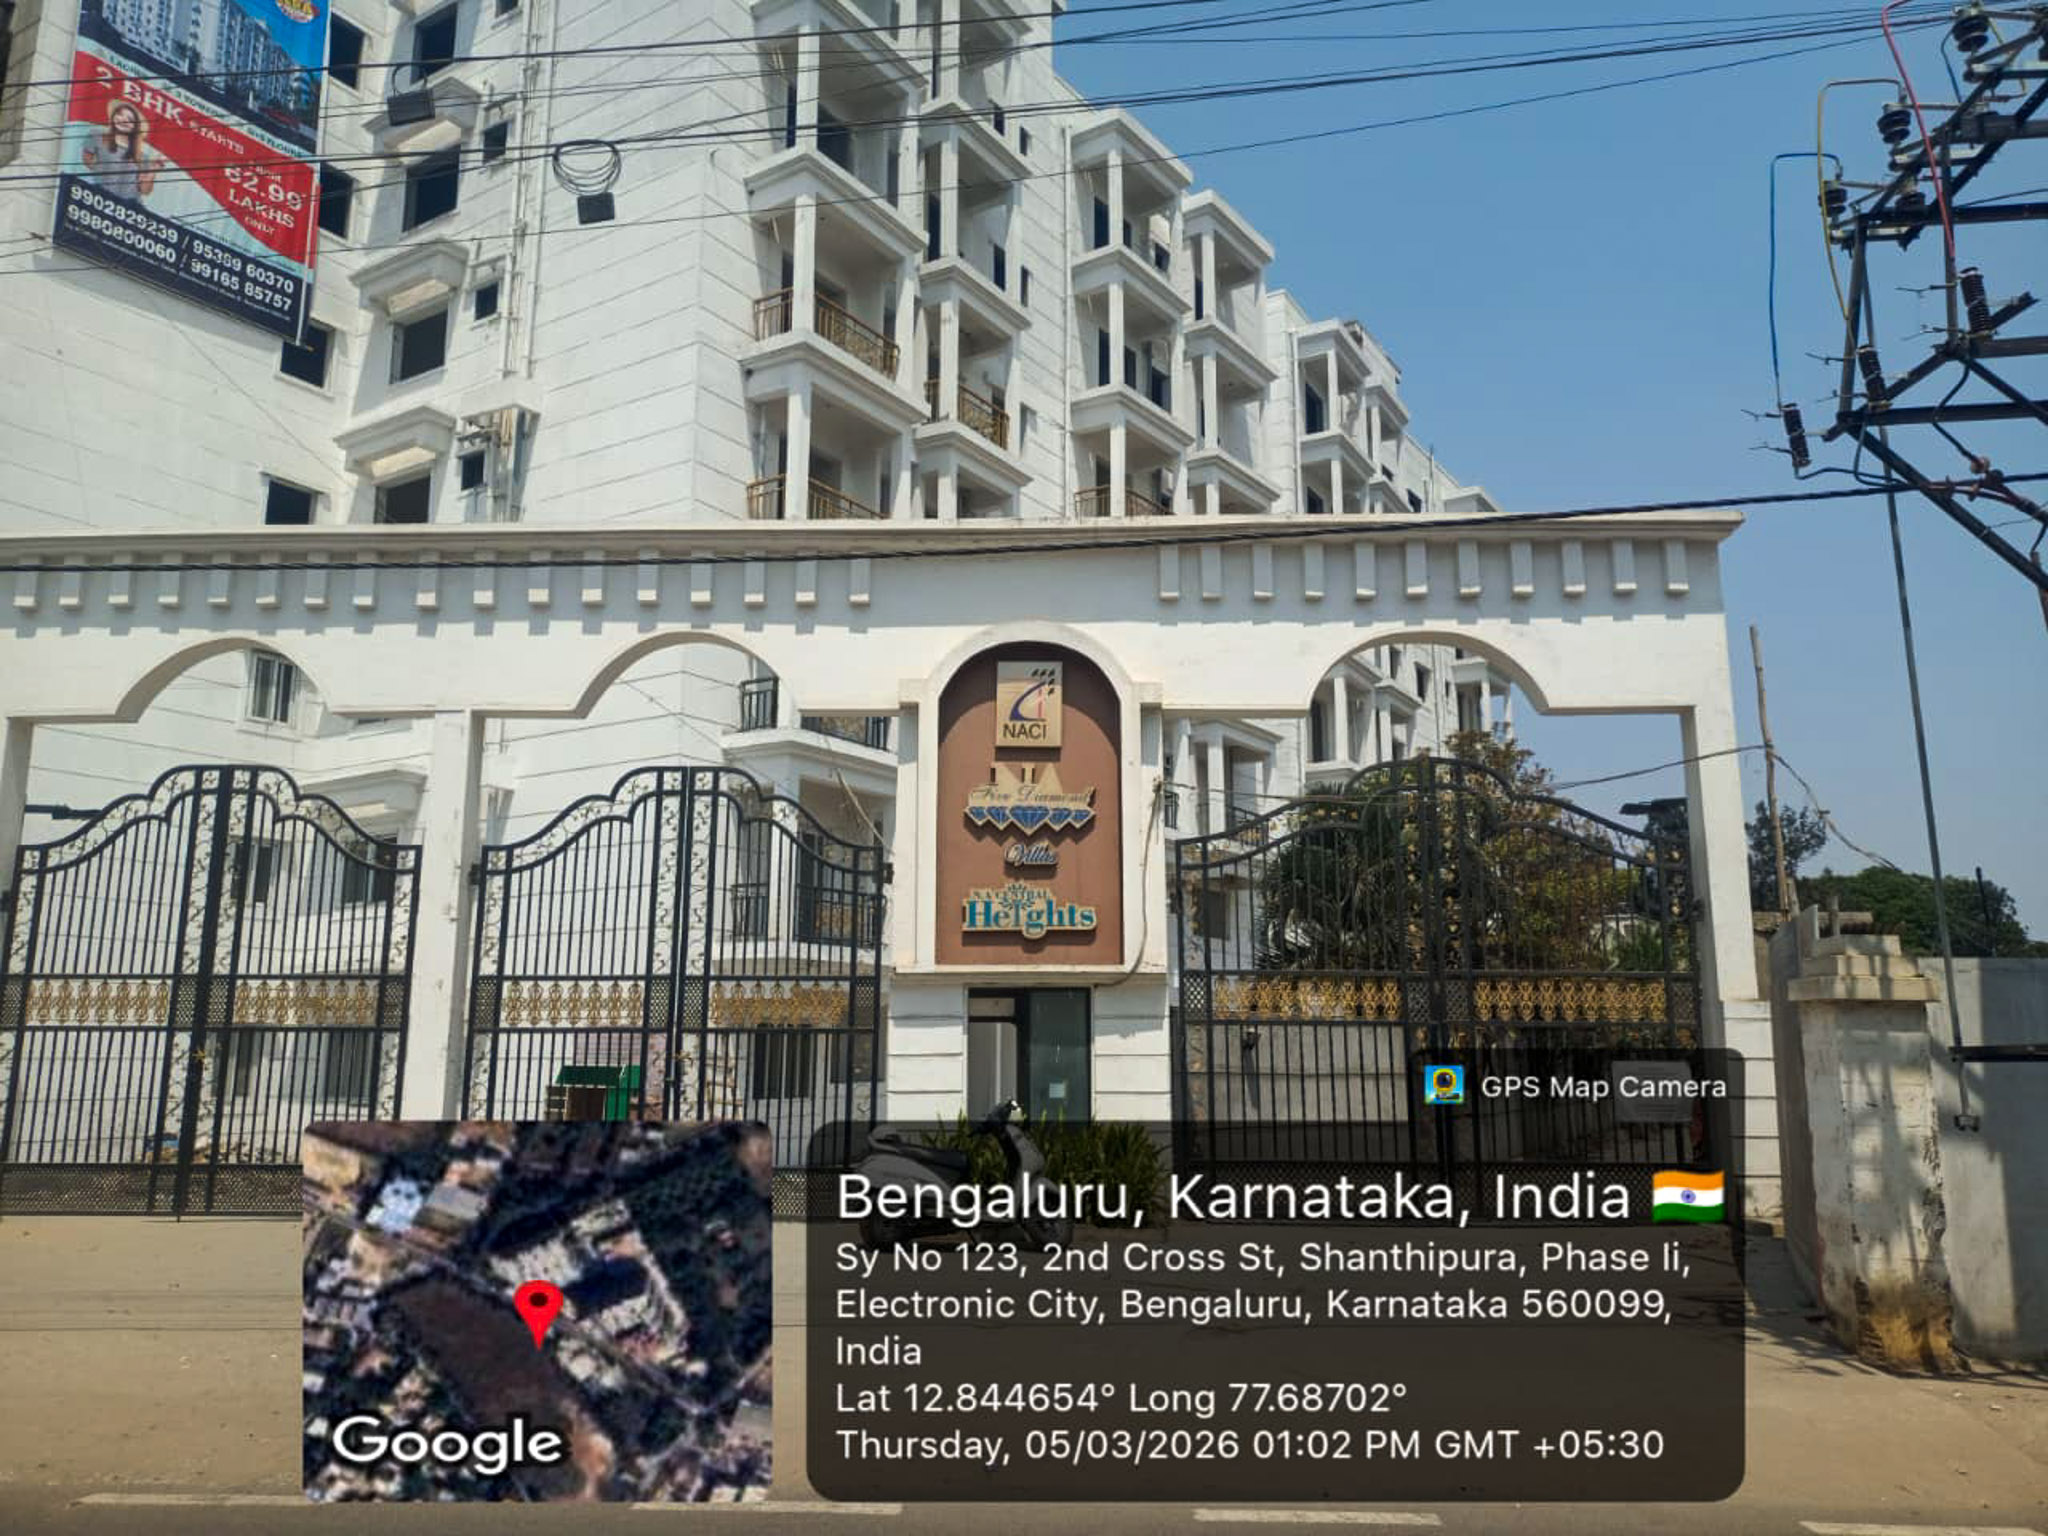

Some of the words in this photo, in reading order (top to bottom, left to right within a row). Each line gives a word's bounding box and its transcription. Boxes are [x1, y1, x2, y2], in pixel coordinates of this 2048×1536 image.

[96, 66, 112, 90] 2
[124, 80, 182, 126] BHK
[229, 188, 294, 229] LAKHS
[1003, 723, 1047, 739] NACI
[967, 899, 1094, 936] Heights
